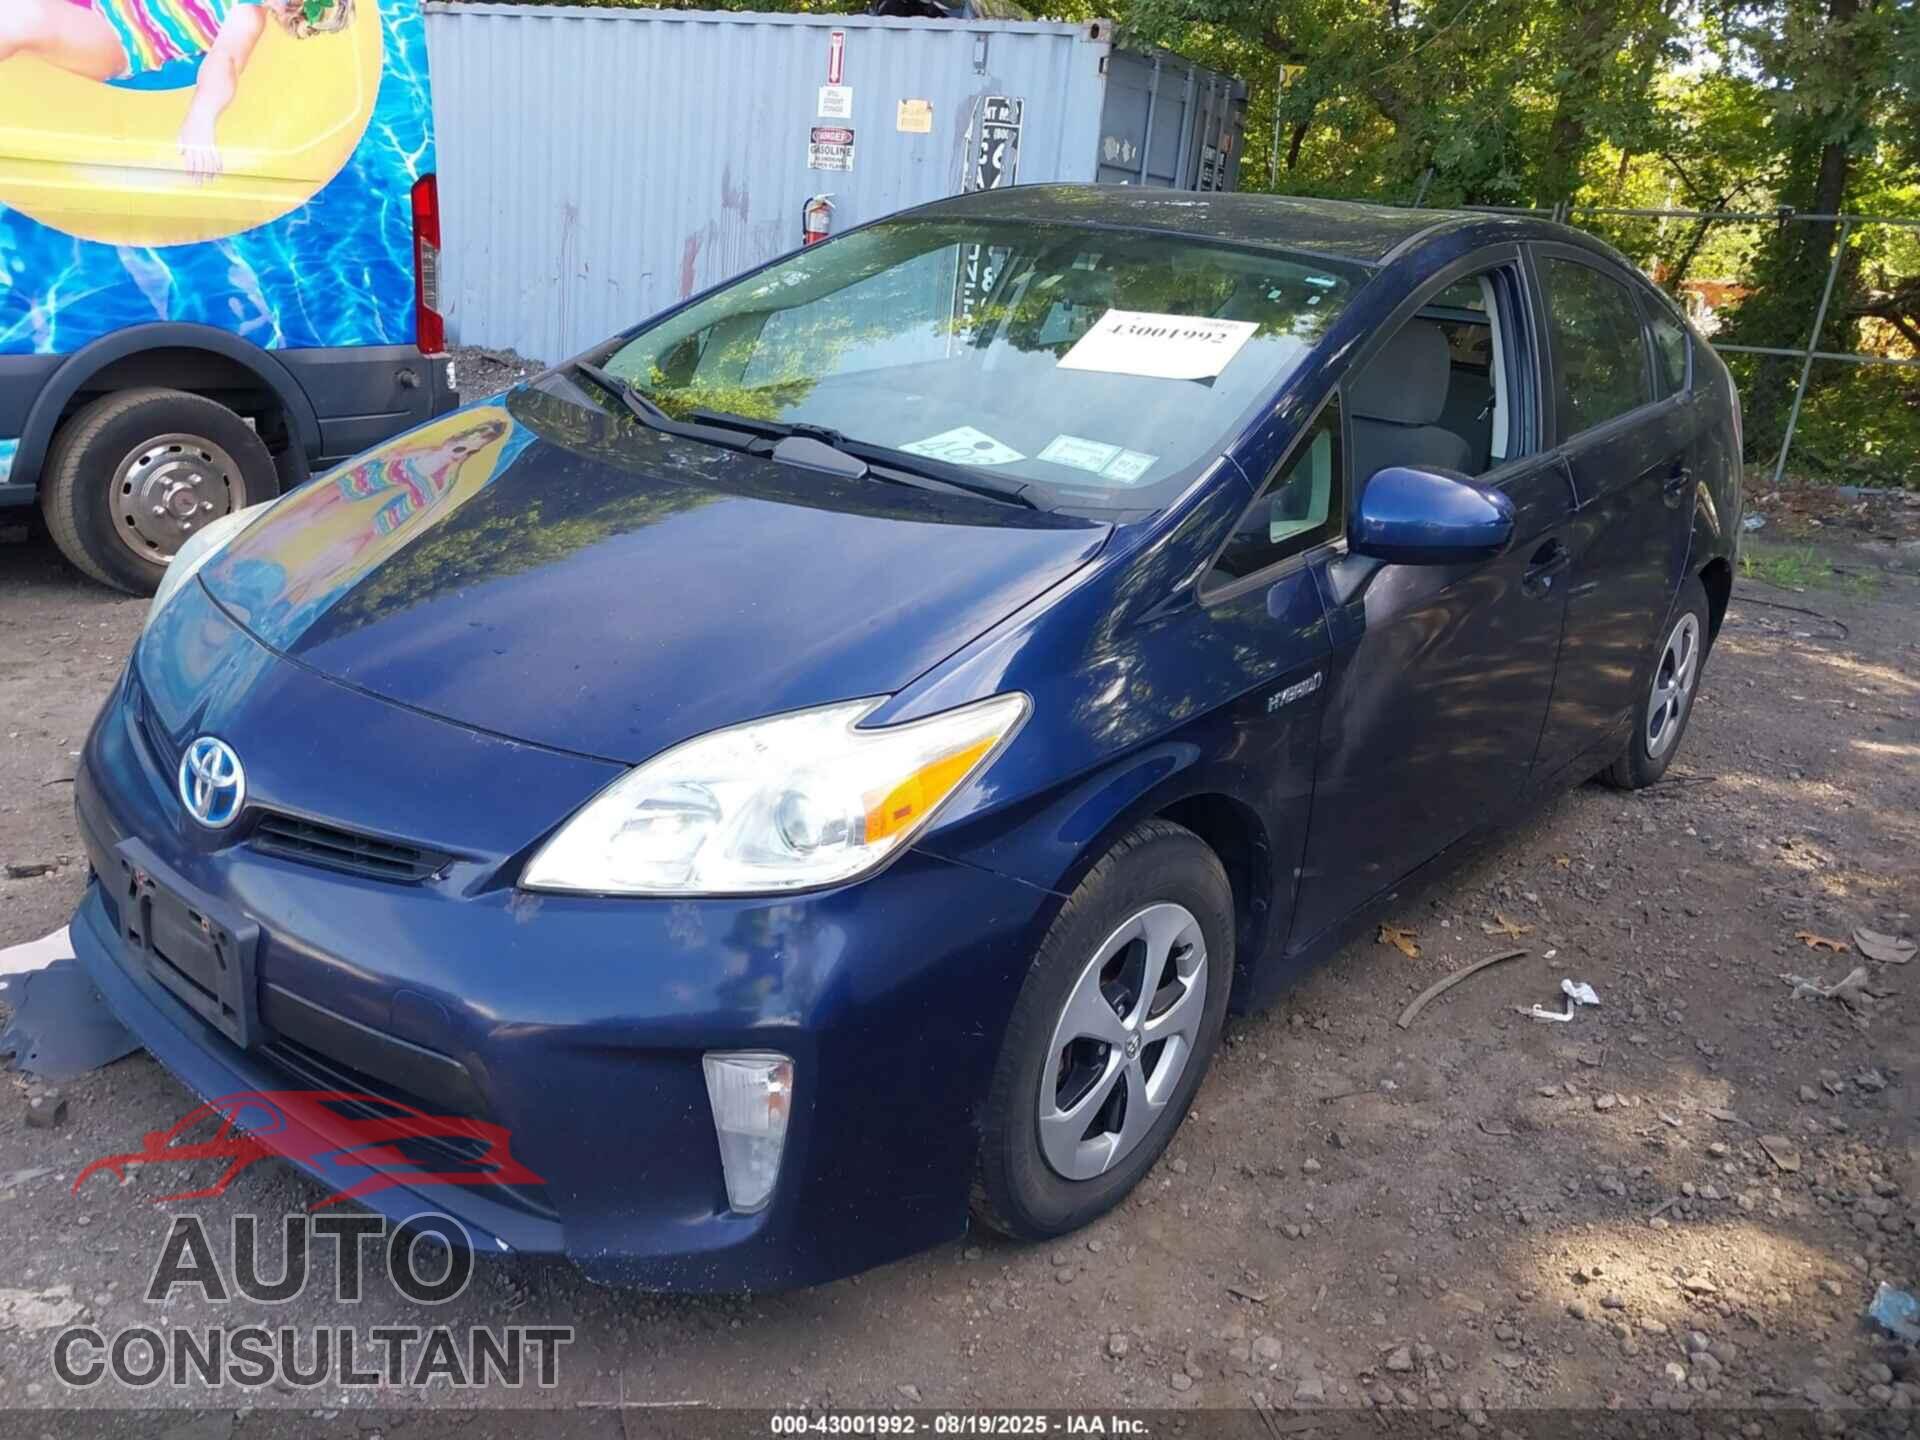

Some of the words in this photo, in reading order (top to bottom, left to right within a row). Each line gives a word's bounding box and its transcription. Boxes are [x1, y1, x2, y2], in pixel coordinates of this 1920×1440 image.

[810, 145, 853, 157] GASOLINE
[1107, 323, 1228, 344] 43001992
[1268, 671, 1323, 713] HYBRID
